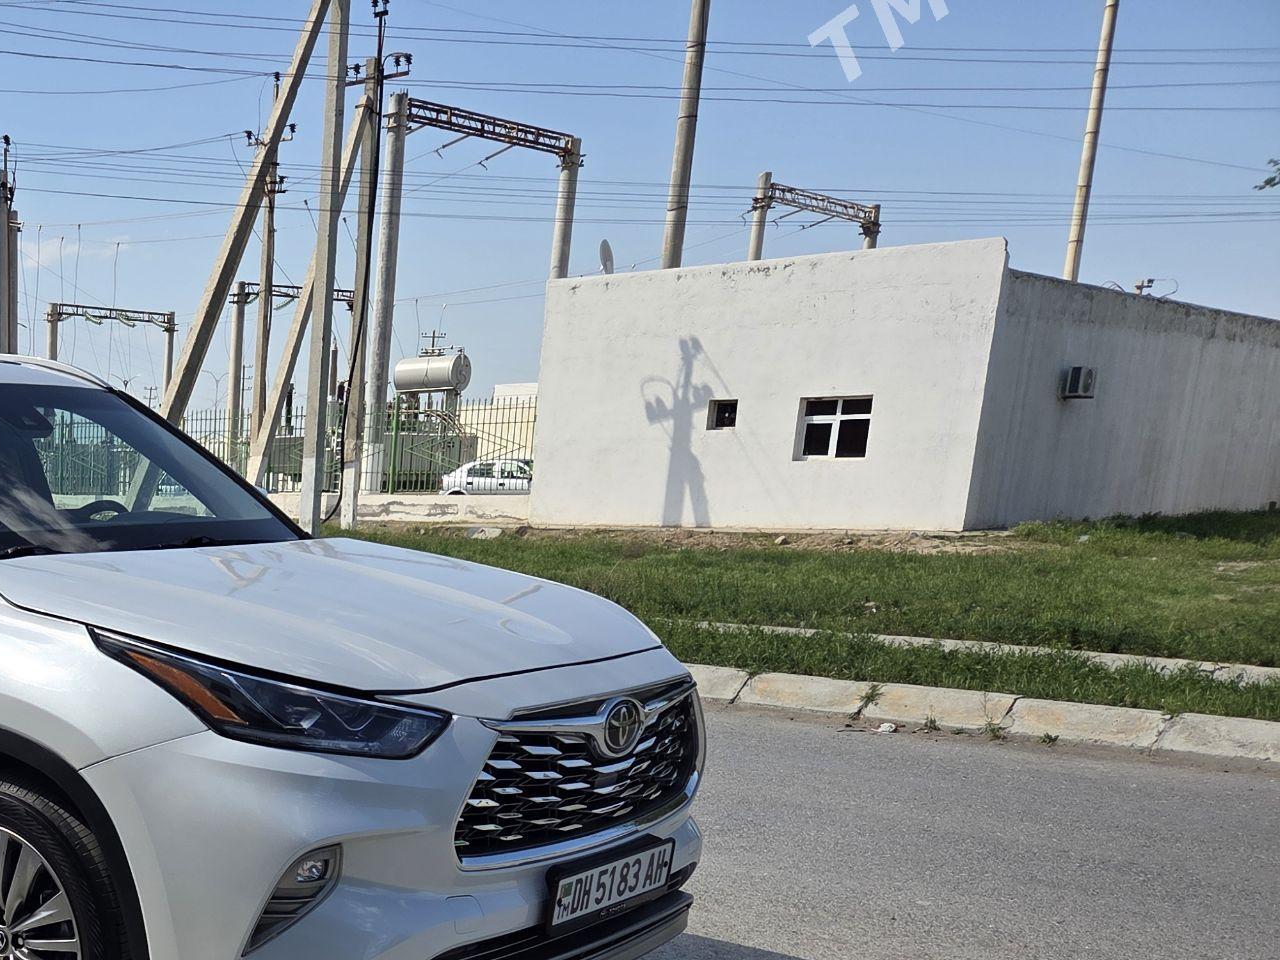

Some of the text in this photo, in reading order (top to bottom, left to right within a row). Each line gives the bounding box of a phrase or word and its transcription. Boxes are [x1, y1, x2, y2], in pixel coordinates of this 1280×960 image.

[570, 873, 594, 915] DH
[595, 858, 642, 905] 5183
[642, 848, 667, 889] AH
